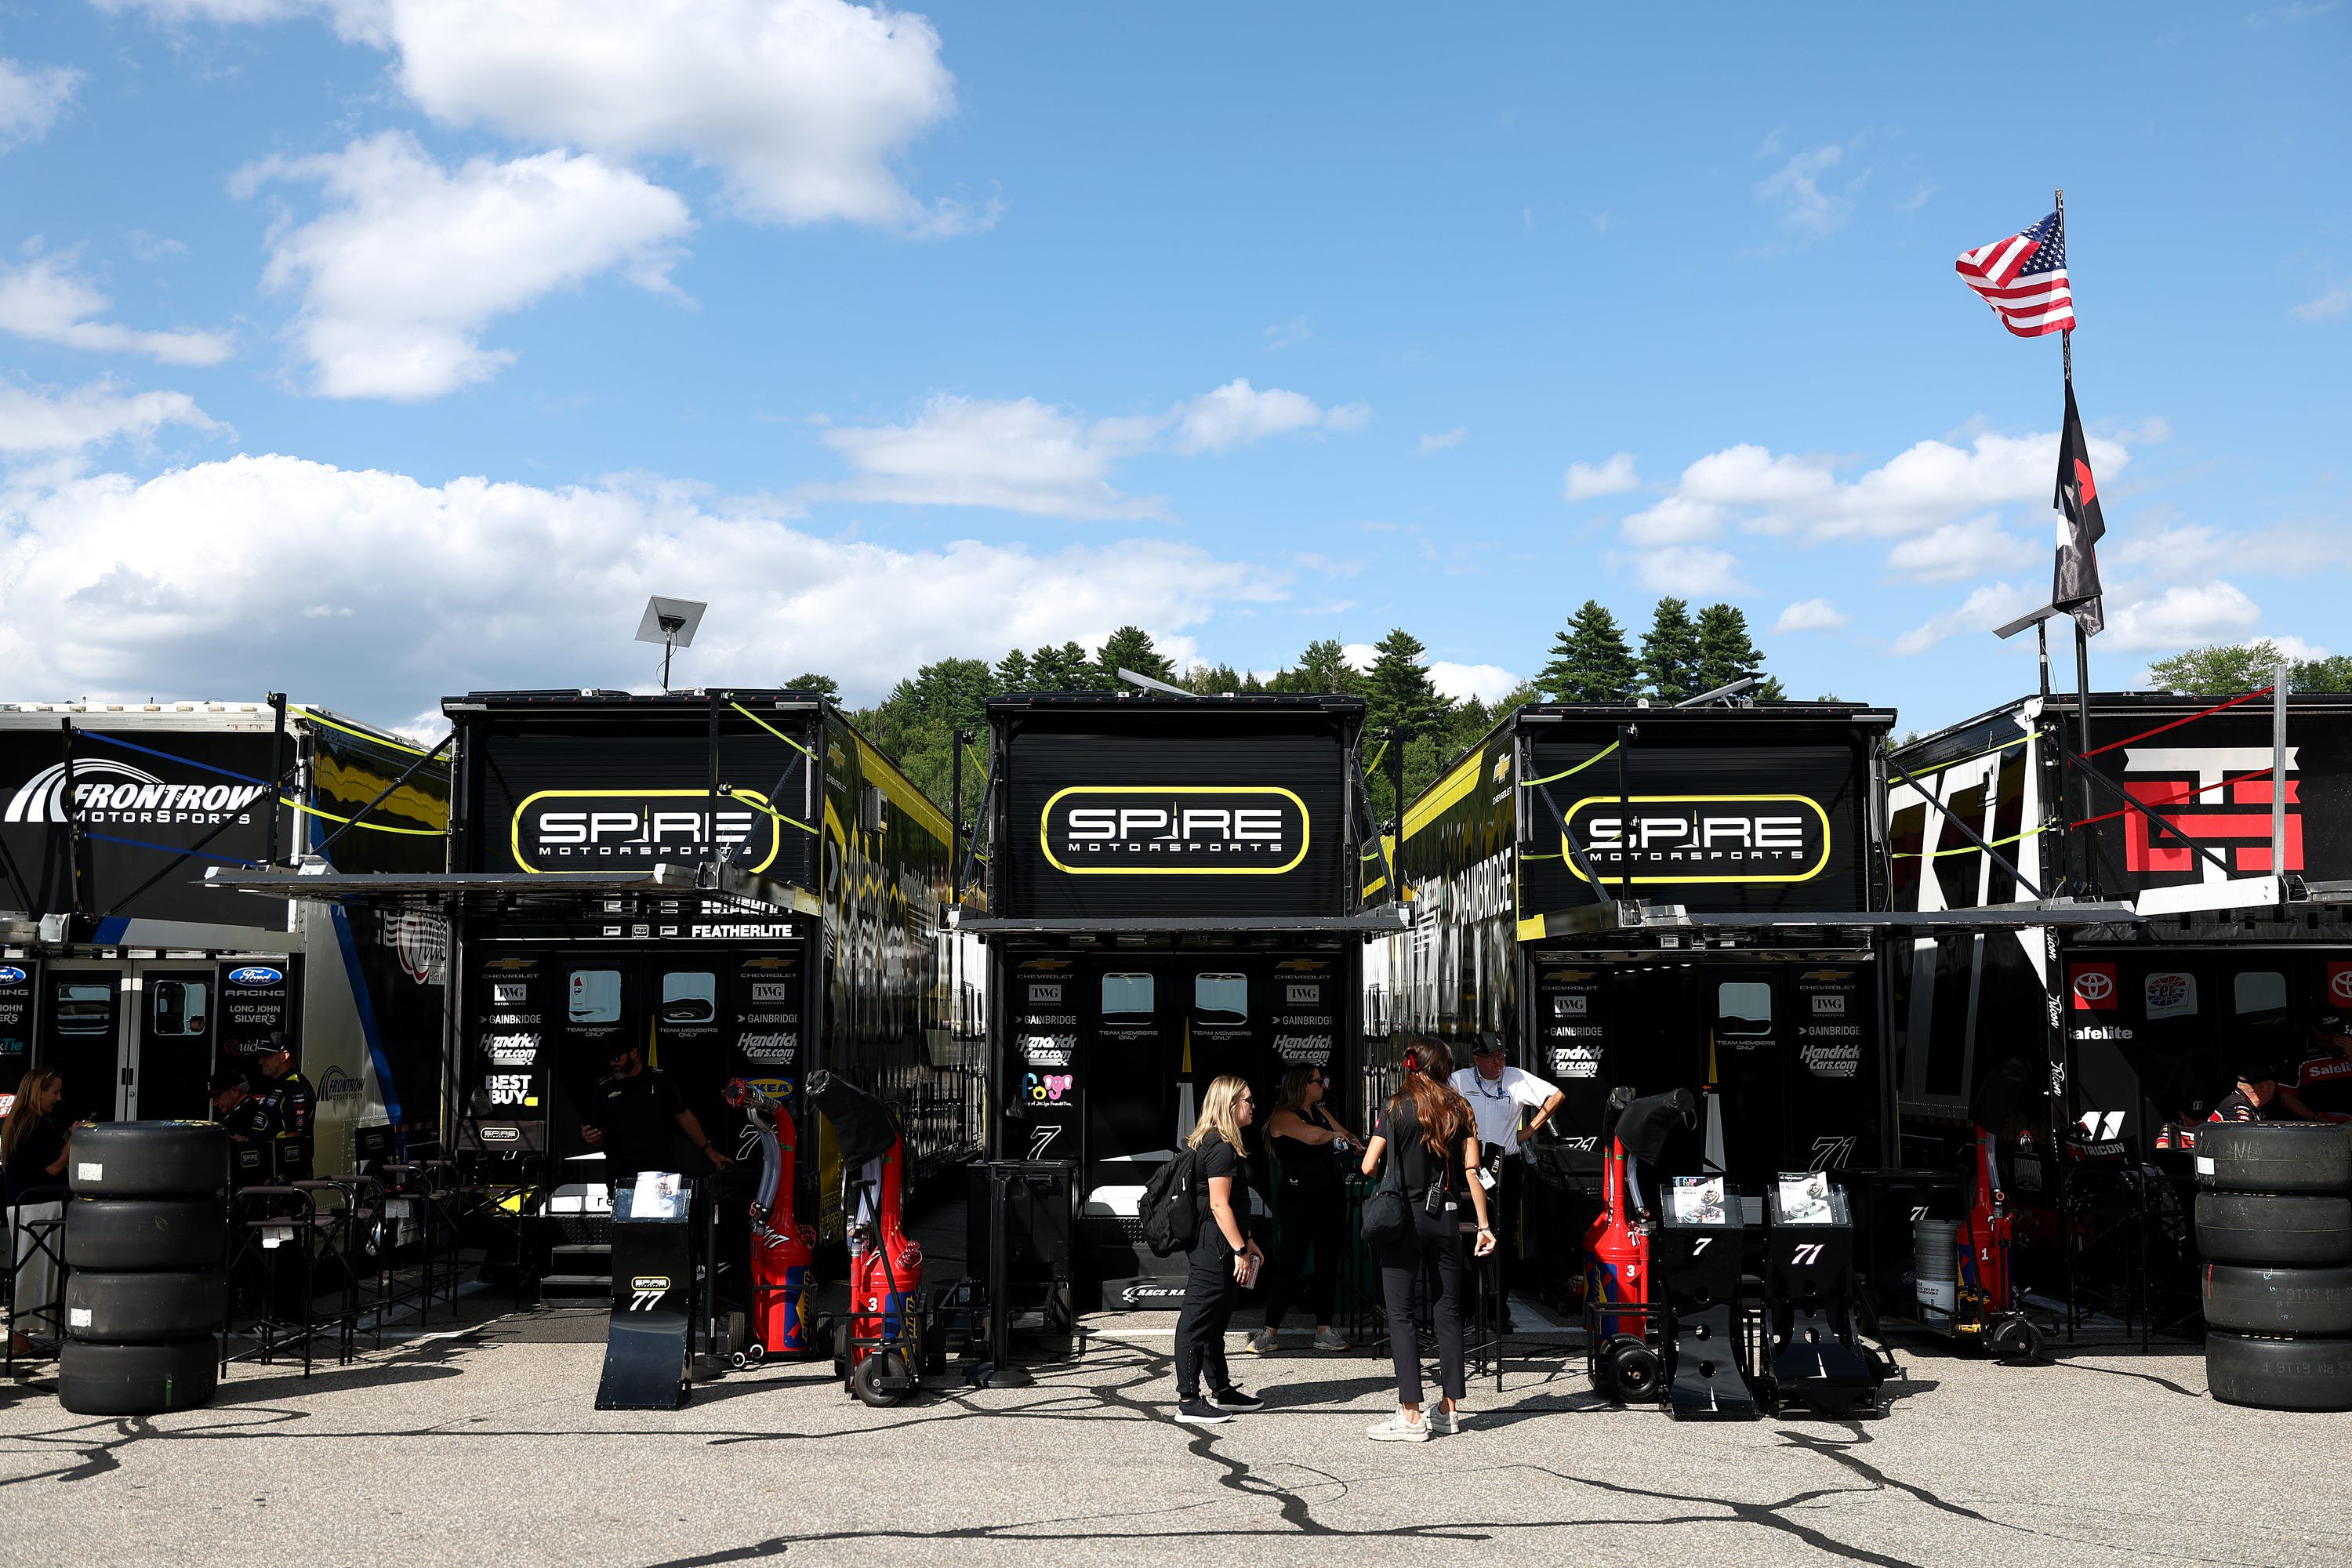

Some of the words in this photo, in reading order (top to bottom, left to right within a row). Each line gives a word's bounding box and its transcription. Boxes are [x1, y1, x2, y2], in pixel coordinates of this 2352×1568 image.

[1492, 786, 1512, 805] CHEVROLET
[539, 804, 752, 844] SPIRE
[1069, 801, 1282, 840] SPIRE
[1589, 810, 1803, 849] SPIRE
[1069, 843, 1282, 851] MOTORSPORTS
[1590, 851, 1803, 861] MOTORSPORTS
[1460, 847, 1512, 927] GAINBRIDGE
[691, 924, 793, 938] FEATHERLITE
[240, 969, 273, 983] Ford
[499, 987, 524, 996] TWG
[755, 986, 782, 996] TWG
[1031, 988, 1058, 998] TWG
[1290, 988, 1316, 998] TWG
[1557, 999, 1584, 1009] TWG
[1815, 998, 1842, 1009] TWG
[2048, 993, 2063, 1029] Tricon
[234, 1014, 277, 1025] SILVER'S
[489, 1014, 542, 1024] GAINBRIDGE
[1024, 1015, 1077, 1025] GAINBRIDGE
[1550, 1026, 1602, 1036] GAINBRIDGE
[1809, 1026, 1861, 1036] GAINBRIDGE
[478, 1033, 542, 1051] Hendrick
[1015, 1034, 1078, 1051] Hendrick
[488, 1047, 536, 1058] Cars.com
[746, 1047, 795, 1058] Cars.com
[1023, 1048, 1072, 1059] Cars.com
[1282, 1049, 1330, 1059] Cars.com
[1544, 1045, 1604, 1064] Hendrick
[1799, 1044, 1862, 1063] Hendrick
[1551, 1061, 1599, 1071] Cars.com
[1809, 1059, 1858, 1070] Cars.com
[2309, 1062, 2352, 1077] Safeli
[328, 1078, 366, 1093] FRONTROW
[485, 1075, 532, 1090] BEST
[2050, 1060, 2065, 1097] Tricon
[754, 1083, 789, 1093] KEA
[488, 1090, 528, 1105] BUY
[1027, 1125, 1062, 1160] 7
[2081, 1142, 2125, 1156] TRICON
[1809, 1136, 1857, 1173] 71
[1909, 1206, 1929, 1221] 71
[1693, 1237, 1713, 1256] 7
[1791, 1243, 1825, 1265] 71
[1981, 1248, 1988, 1260] 1
[1626, 1264, 1635, 1277] 3
[630, 1290, 666, 1312] 77
[868, 1298, 878, 1312] 3
